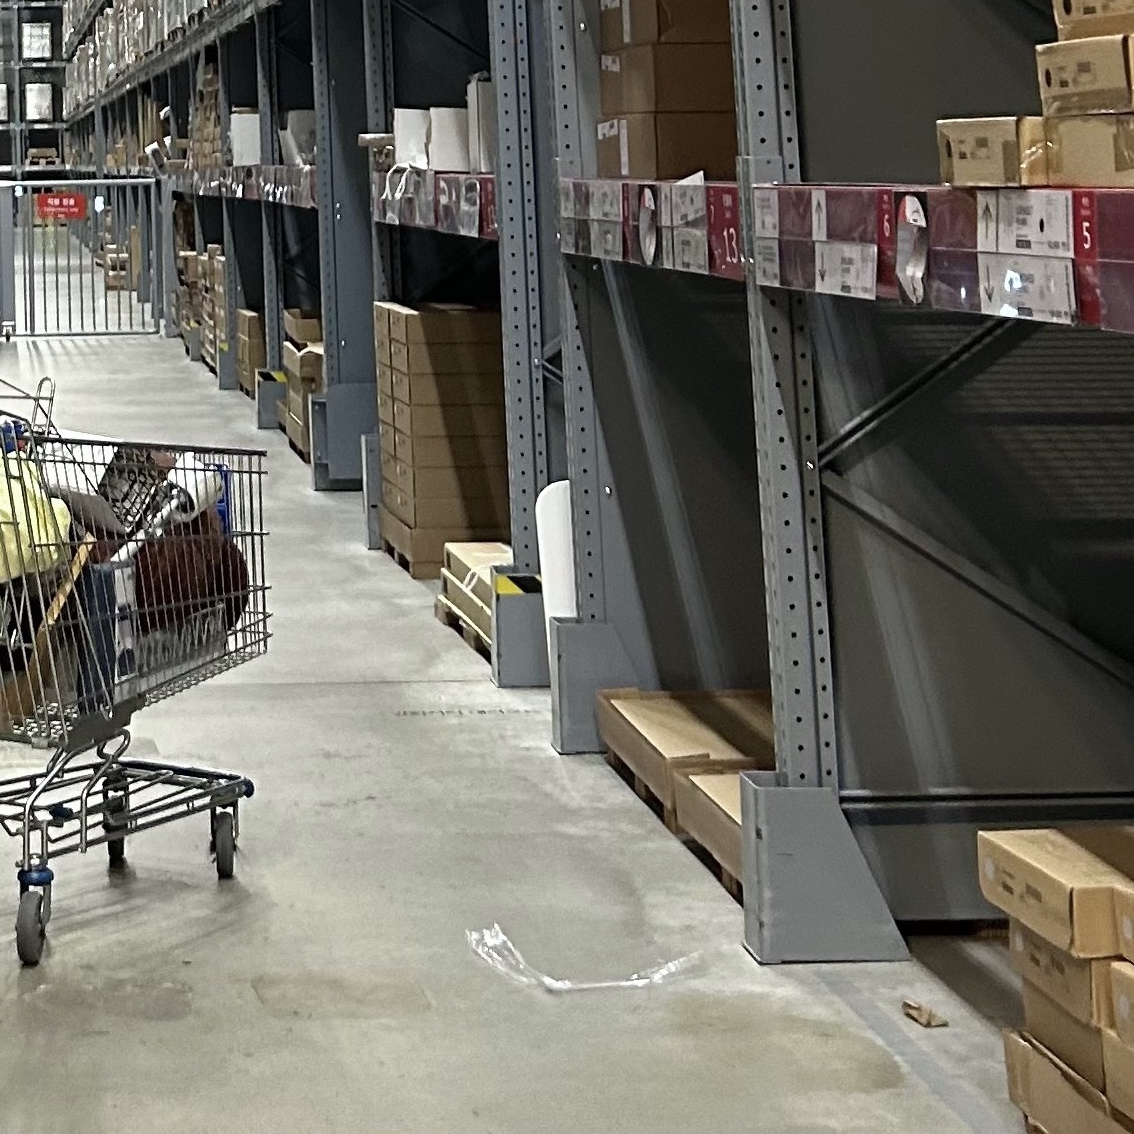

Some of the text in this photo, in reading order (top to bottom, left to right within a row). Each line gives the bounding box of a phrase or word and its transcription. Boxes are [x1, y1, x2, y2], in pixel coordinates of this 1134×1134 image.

[882, 214, 890, 238] 6
[1082, 222, 1091, 249] 5
[723, 227, 738, 264] 13
